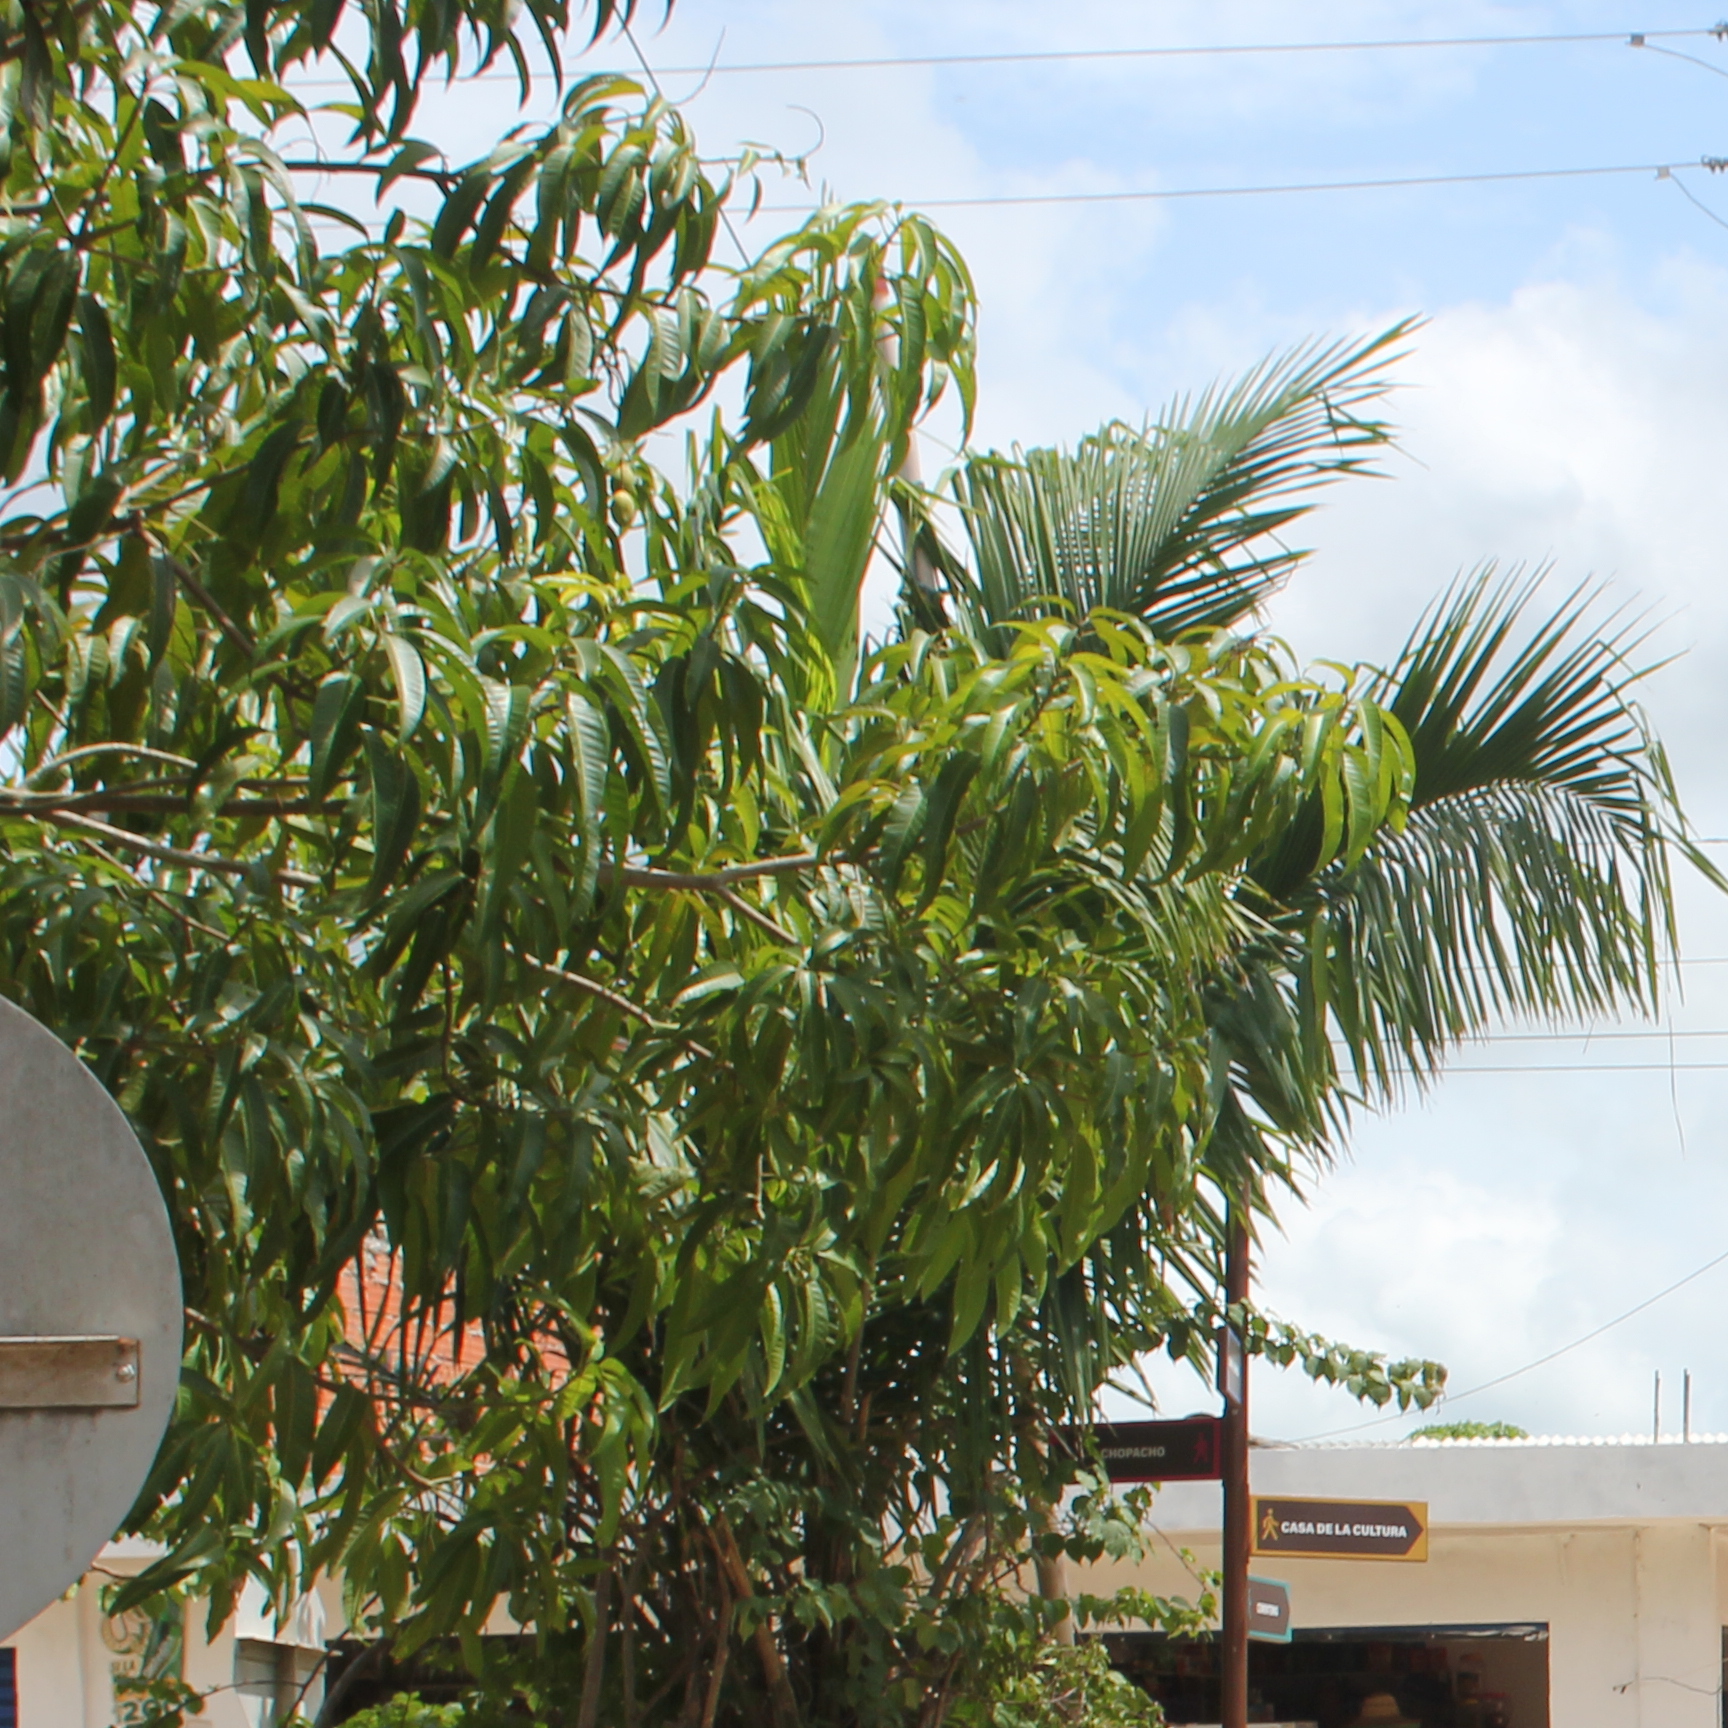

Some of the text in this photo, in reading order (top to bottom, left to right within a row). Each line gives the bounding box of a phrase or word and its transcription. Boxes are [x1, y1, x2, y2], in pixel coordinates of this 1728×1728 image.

[1281, 1521, 1408, 1538] CASA DE LA CULTURA
